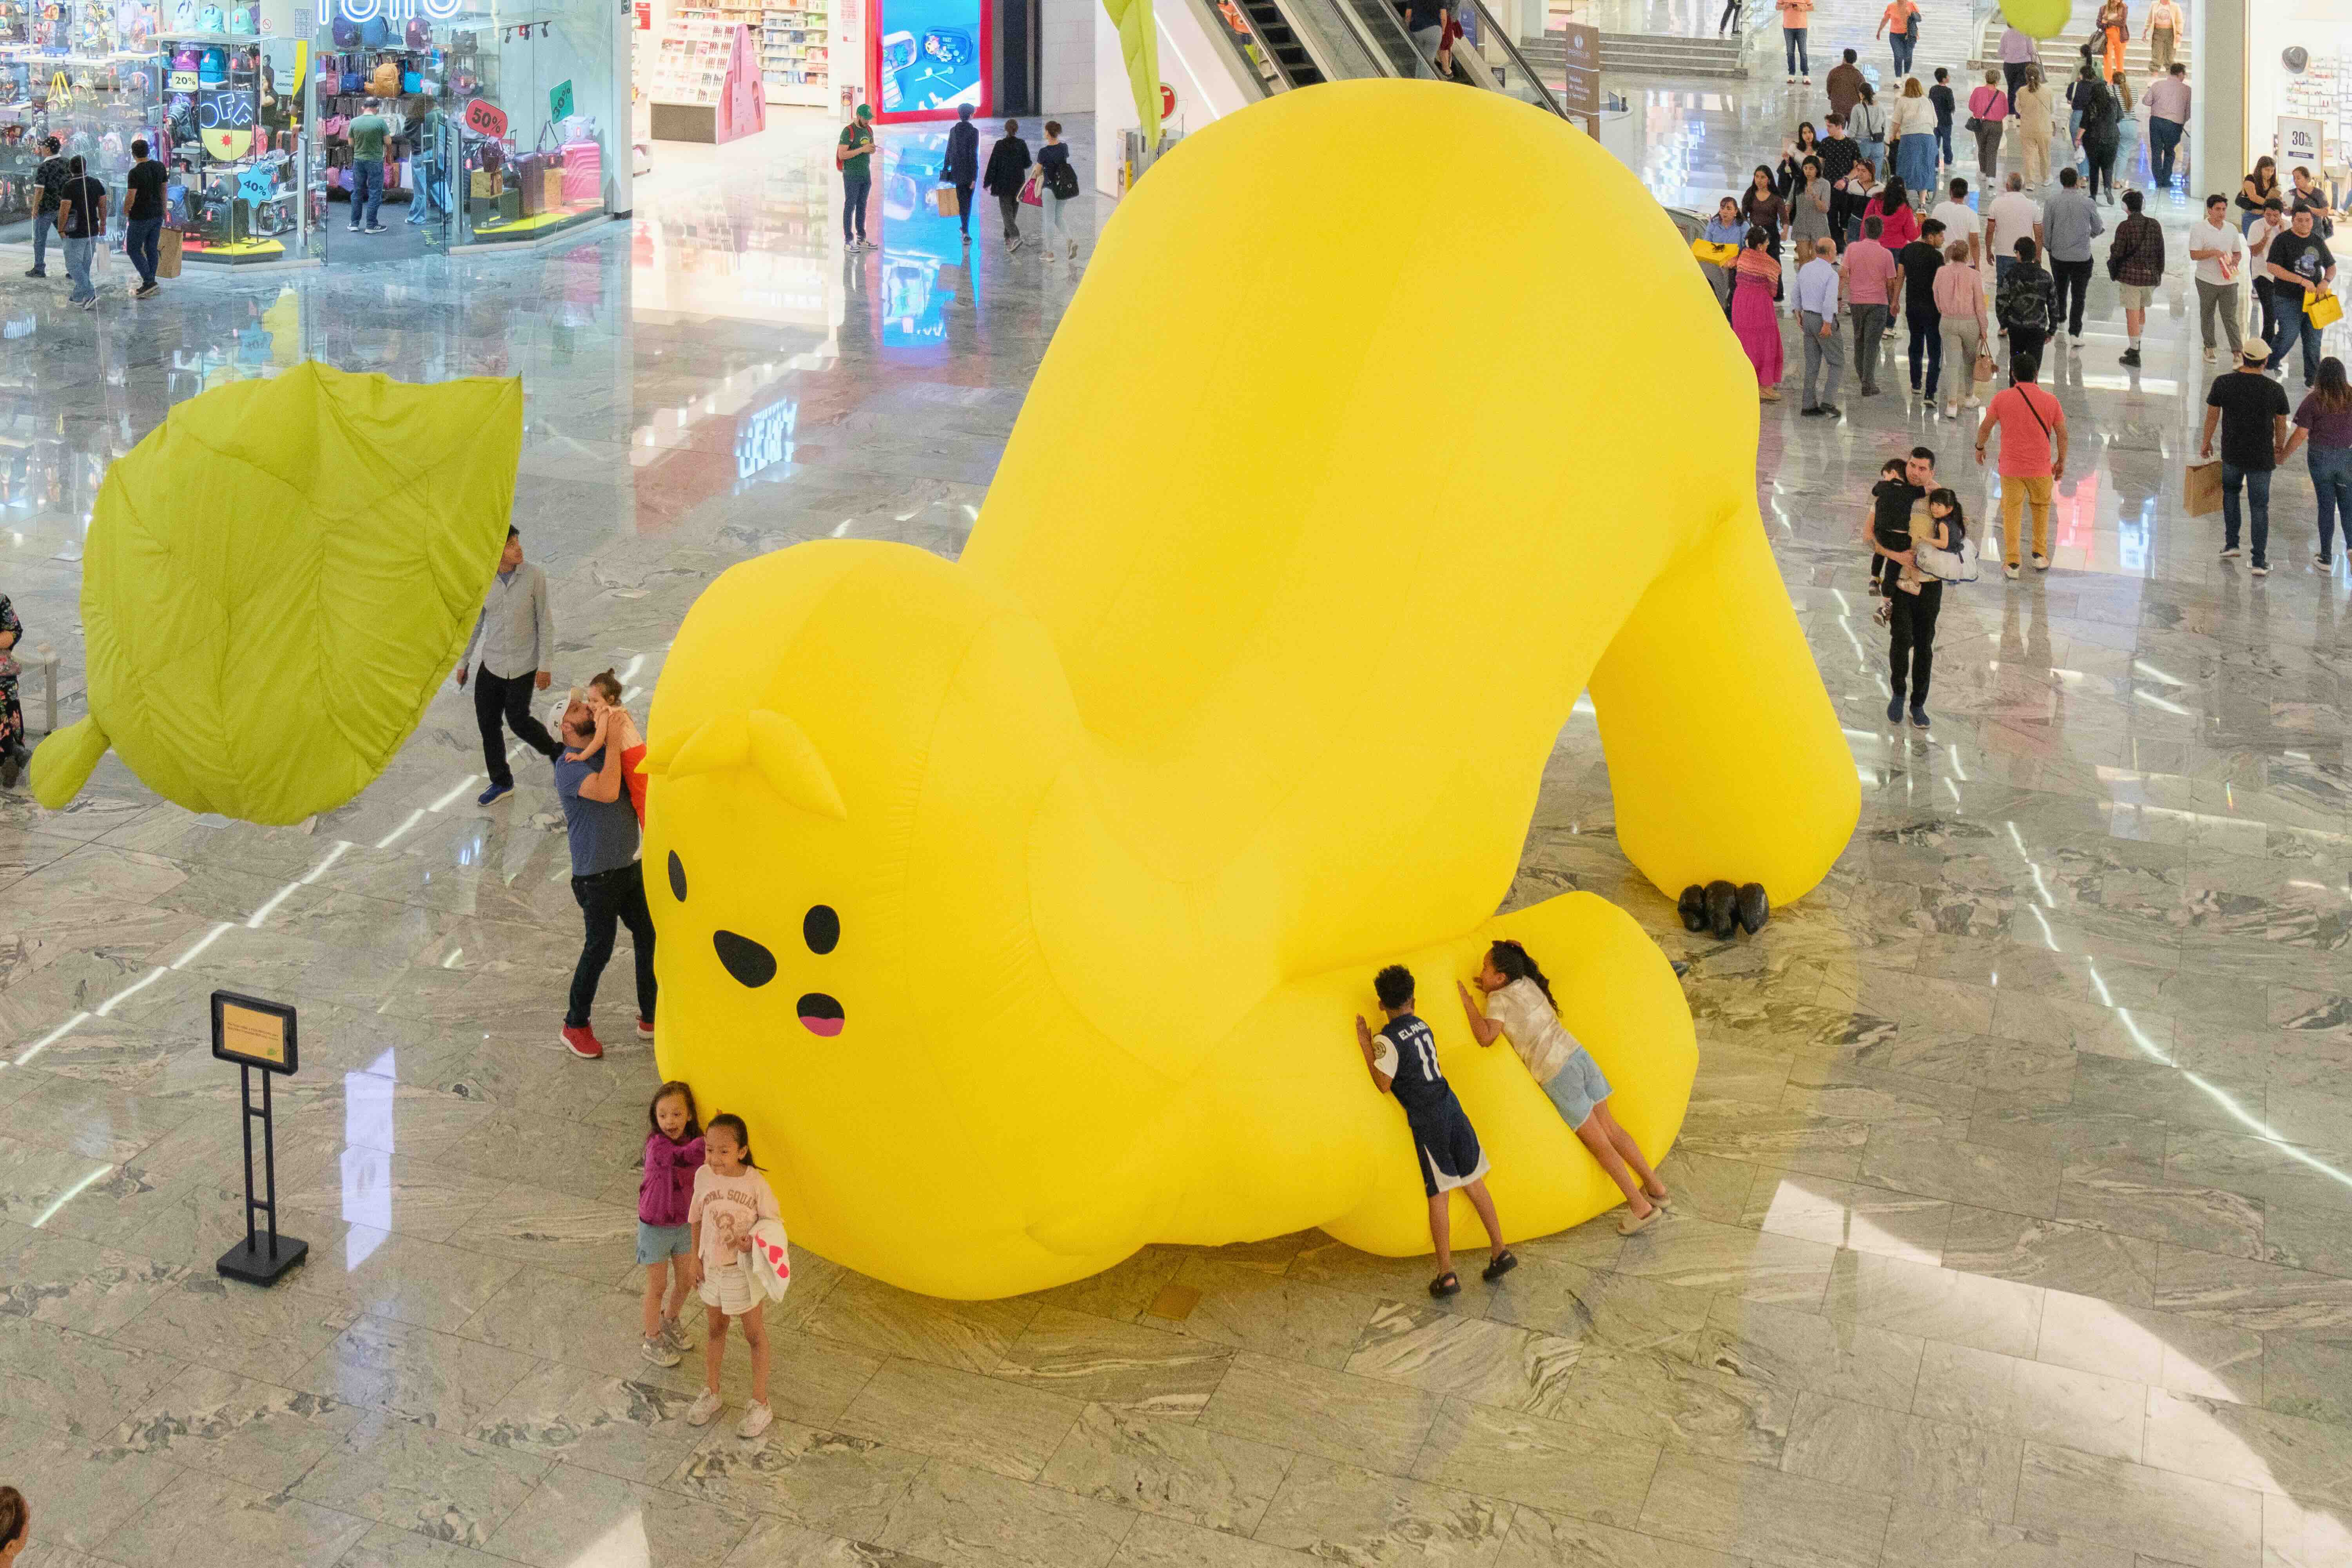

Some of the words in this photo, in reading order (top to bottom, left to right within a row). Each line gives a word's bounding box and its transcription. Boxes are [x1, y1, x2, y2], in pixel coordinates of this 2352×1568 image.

[175, 76, 196, 85] 20%
[472, 107, 502, 133] 50%
[243, 180, 267, 196] 40%
[1398, 1029, 1413, 1040] EL
[1414, 1033, 1442, 1081] 11
